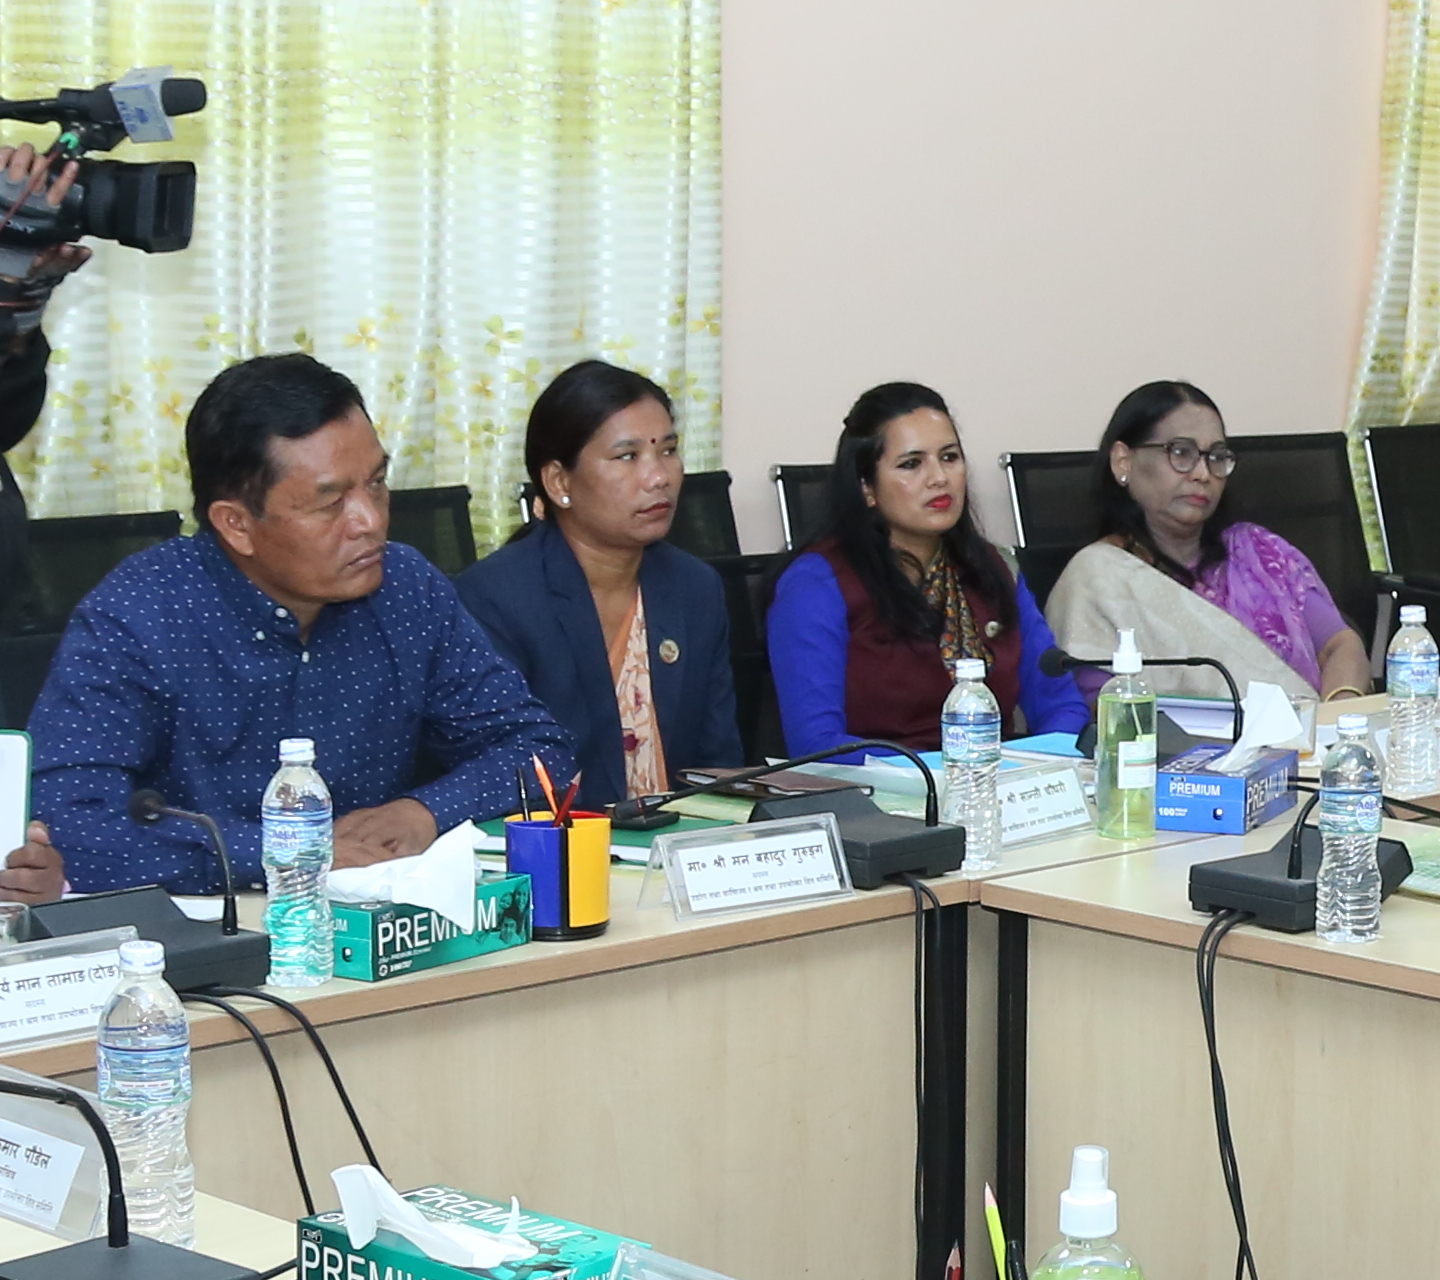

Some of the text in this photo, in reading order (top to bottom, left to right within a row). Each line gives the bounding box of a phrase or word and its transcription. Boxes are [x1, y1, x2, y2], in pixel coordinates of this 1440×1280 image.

[1169, 782, 1221, 796] PREMIUM
[713, 854, 726, 869] श्री
[732, 855, 750, 867] मन
[755, 849, 786, 866] बहादुर
[377, 896, 497, 956] PREMIM
[15, 977, 42, 992] मान
[405, 1187, 582, 1241] PREMUM
